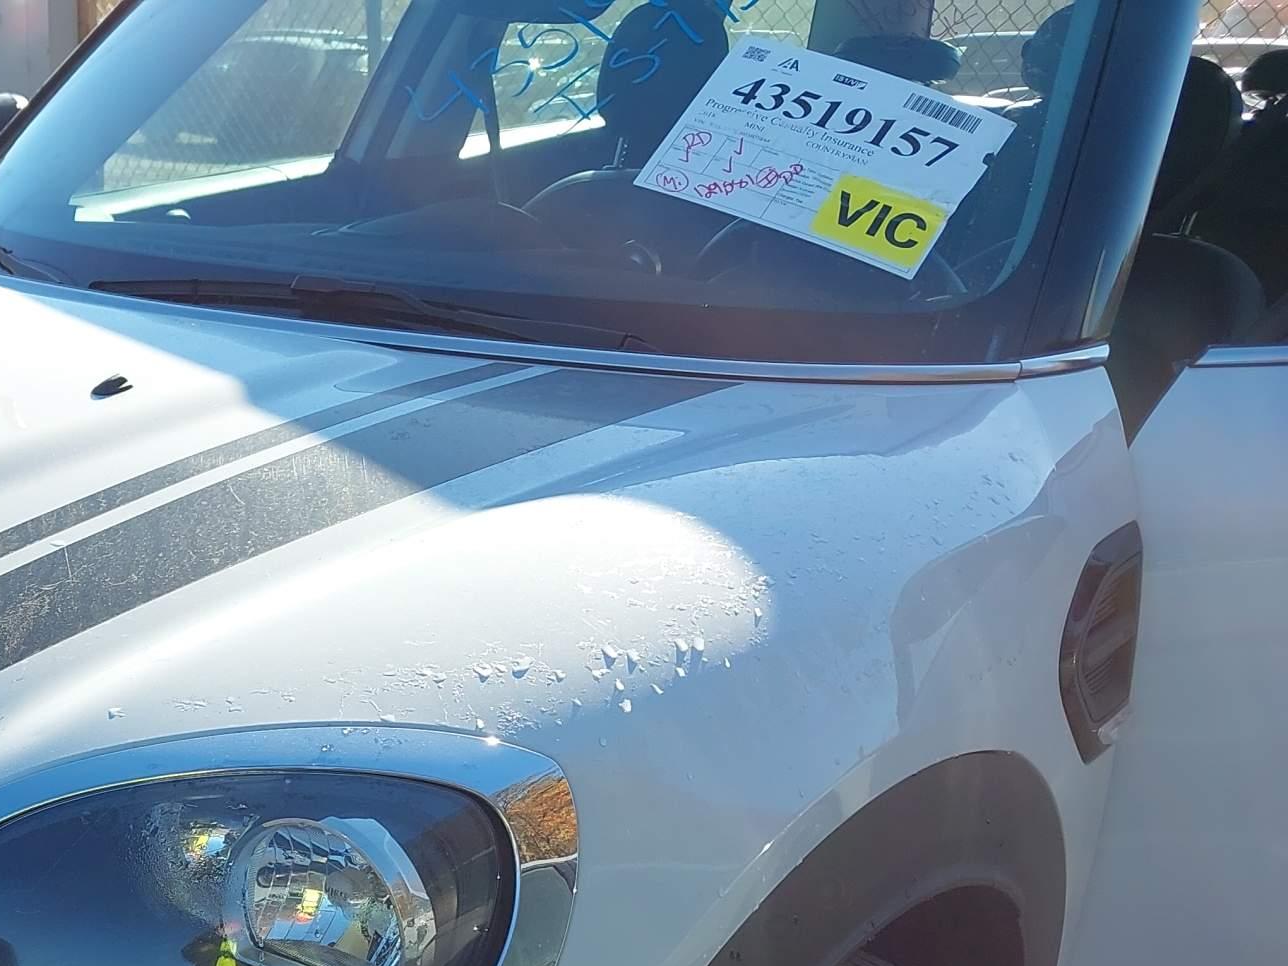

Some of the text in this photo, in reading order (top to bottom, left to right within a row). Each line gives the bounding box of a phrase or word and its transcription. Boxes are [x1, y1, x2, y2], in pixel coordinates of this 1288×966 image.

[732, 77, 959, 167] 43519157
[806, 139, 870, 167] COUNTRYMAN
[820, 130, 875, 158] Insurance
[837, 190, 927, 249] VIC
